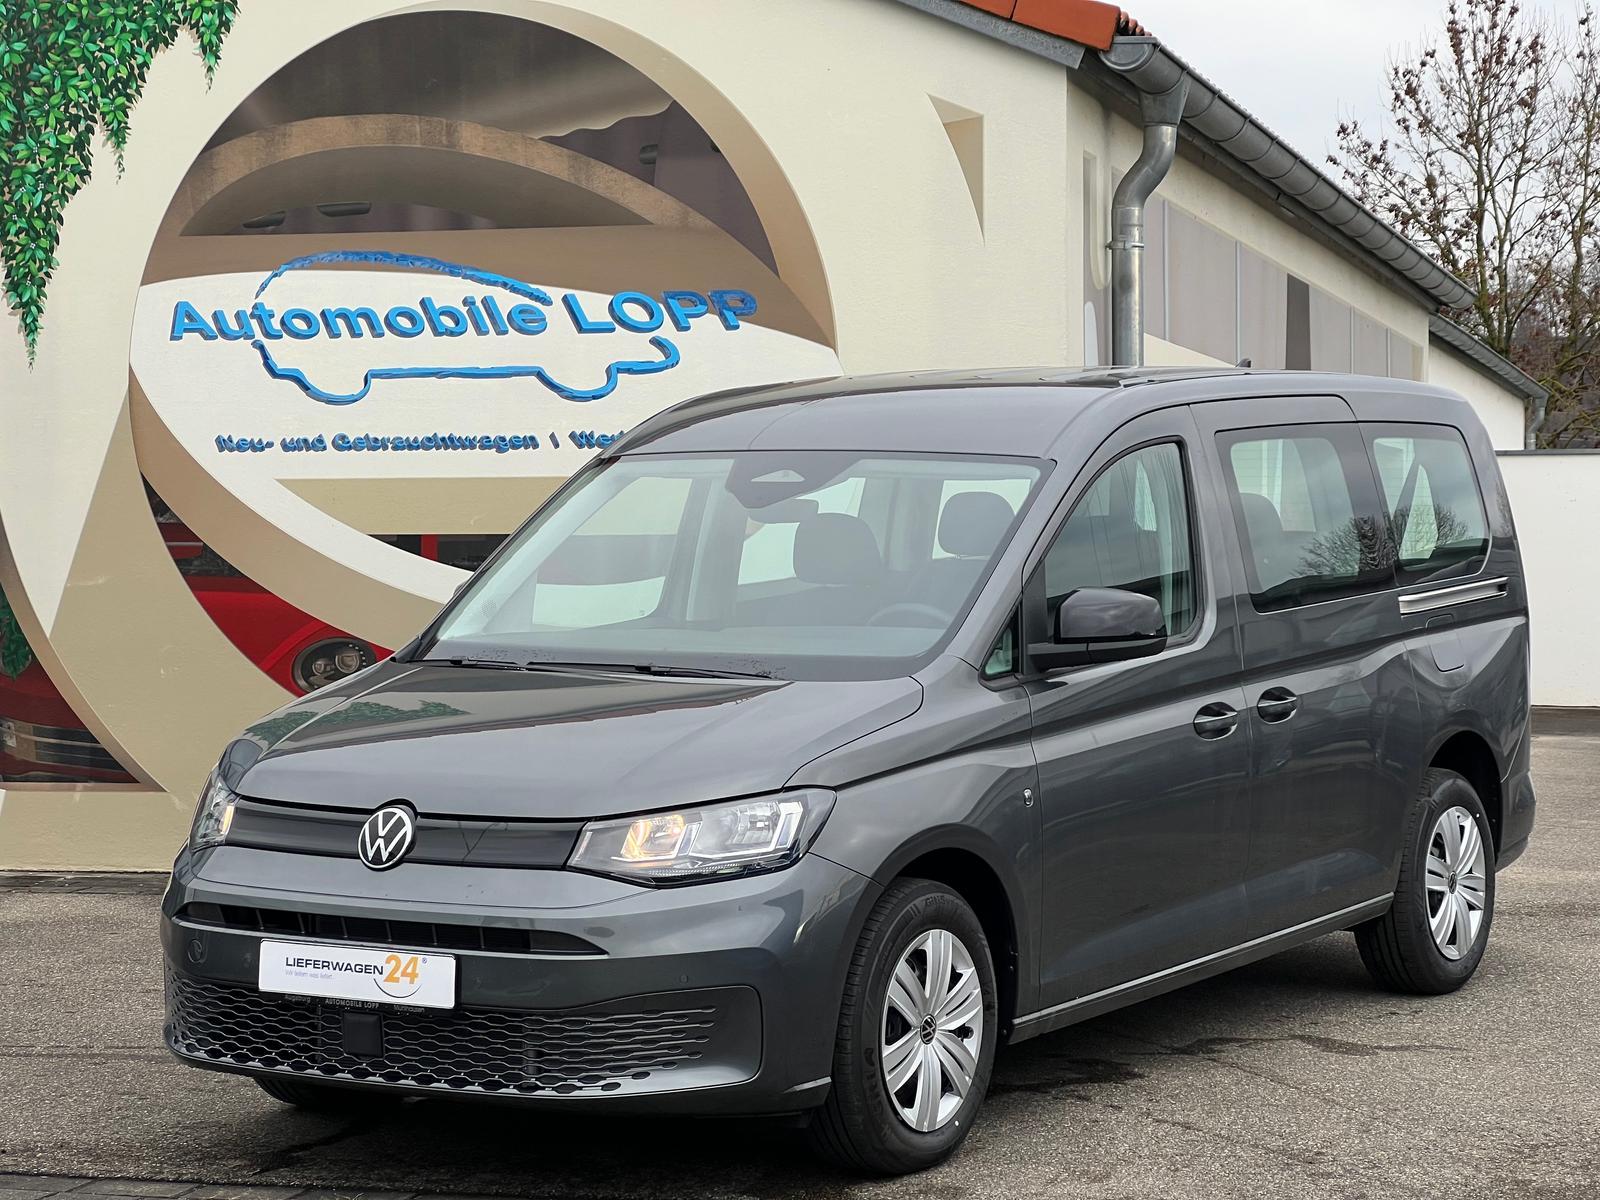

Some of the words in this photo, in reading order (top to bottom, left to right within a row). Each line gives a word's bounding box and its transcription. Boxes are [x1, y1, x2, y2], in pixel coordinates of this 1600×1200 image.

[169, 294, 548, 341] Automobile
[561, 289, 758, 335] LOPP
[214, 434, 275, 453] Neu-
[280, 433, 328, 453] und
[331, 432, 540, 454] Gebrauchtwagen
[285, 957, 384, 976] LIEFERWAGEN
[383, 953, 420, 985] 24
